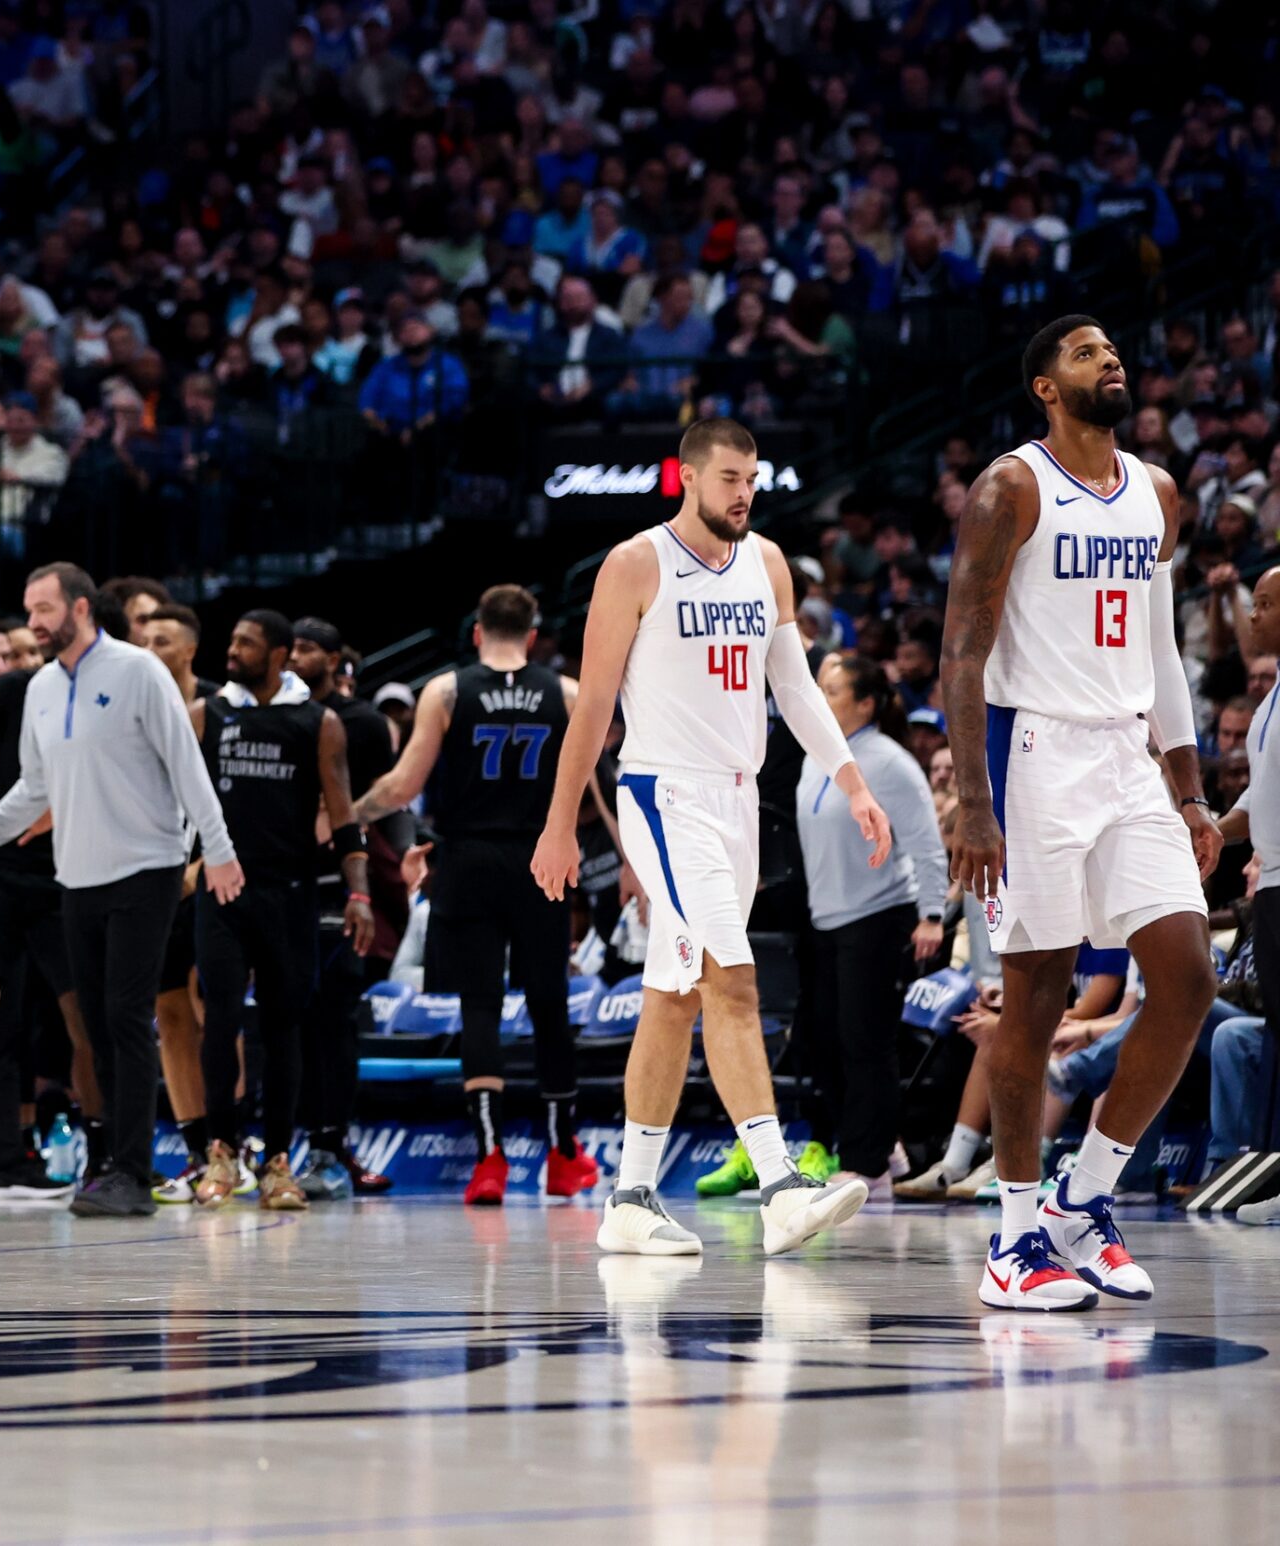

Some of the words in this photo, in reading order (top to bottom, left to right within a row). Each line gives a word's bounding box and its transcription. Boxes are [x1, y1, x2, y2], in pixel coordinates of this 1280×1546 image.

[1054, 532, 1158, 581] CLIPPERS
[677, 600, 765, 638] CLIPPERS
[1095, 590, 1127, 648] 13
[708, 645, 748, 691] 40
[473, 723, 552, 780] 77
